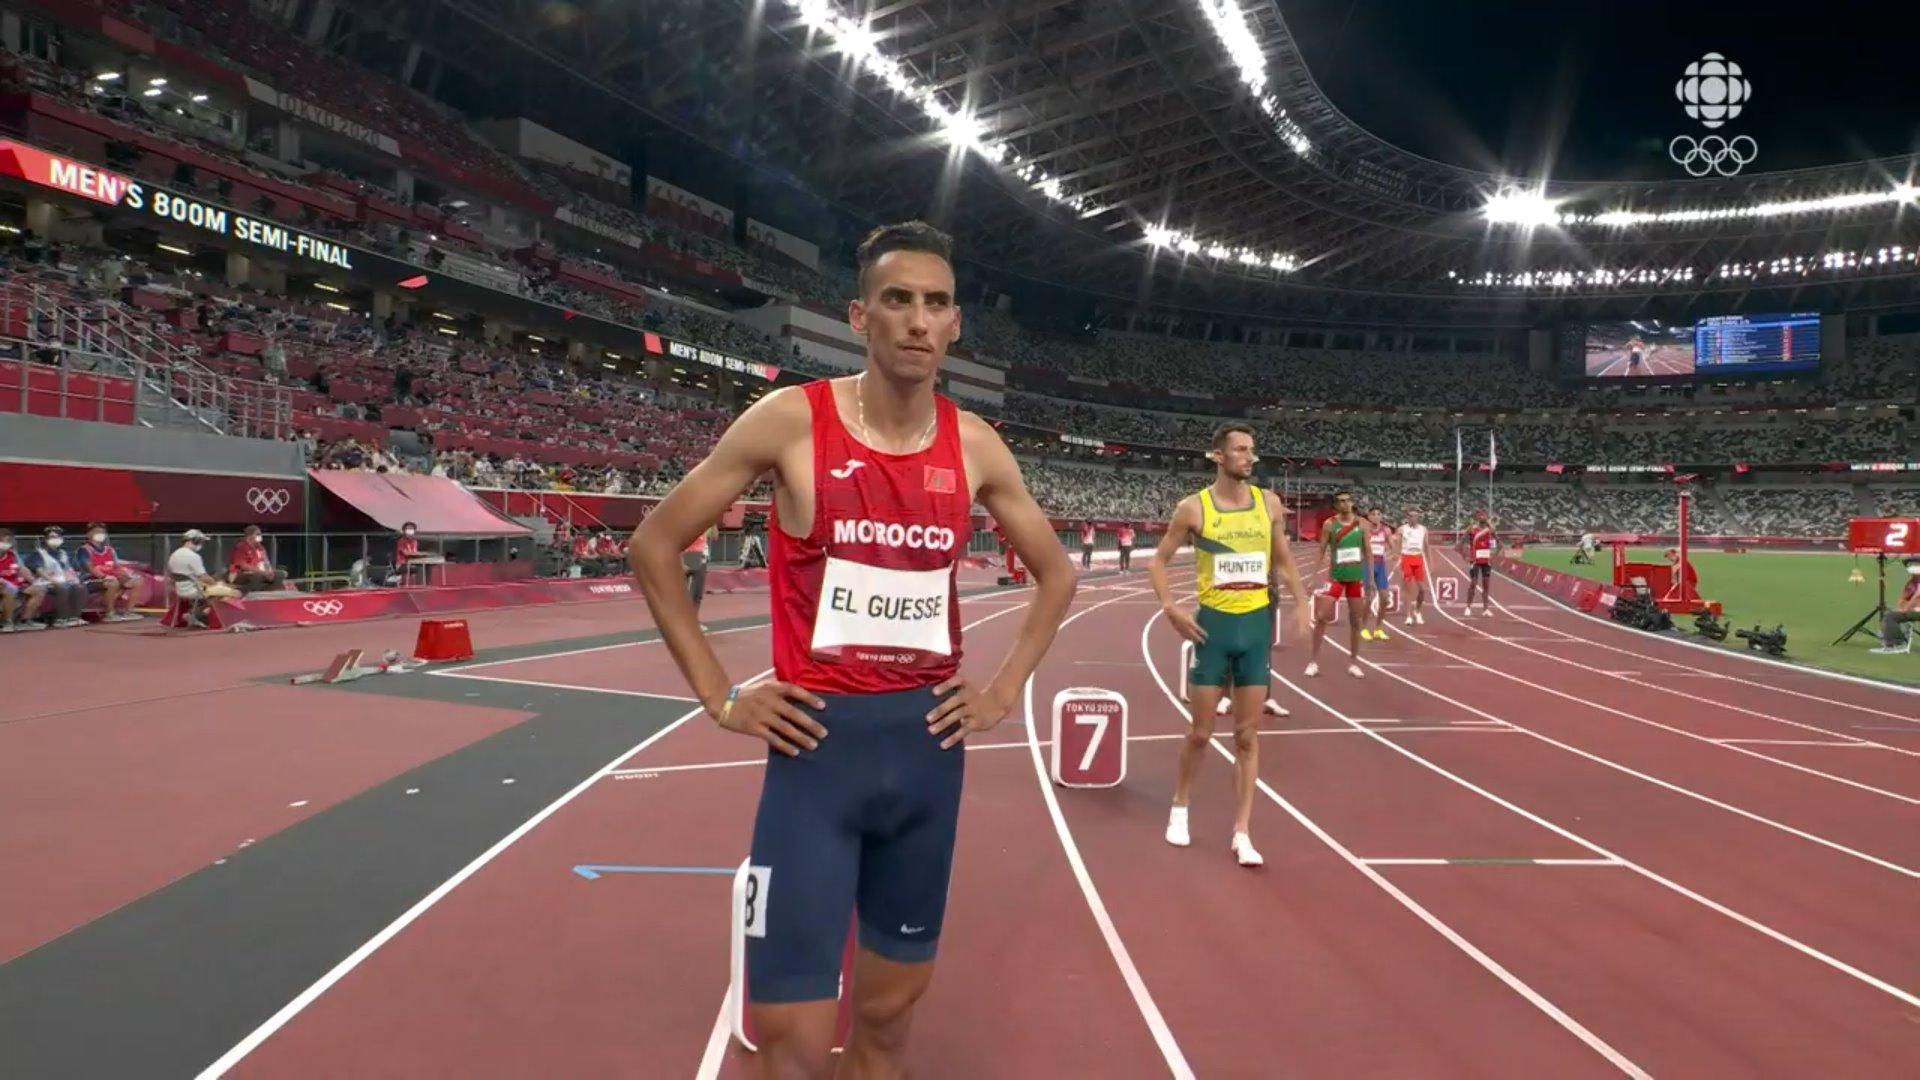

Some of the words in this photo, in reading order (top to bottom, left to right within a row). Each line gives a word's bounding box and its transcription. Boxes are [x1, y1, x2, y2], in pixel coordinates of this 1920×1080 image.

[50, 158, 144, 209] MEN'S
[153, 192, 227, 234] 800M
[234, 216, 353, 270] SEMI-FINAL
[833, 519, 955, 550] MOROCCO
[1885, 523, 1909, 547] 2
[1218, 560, 1263, 573] HUNTER
[831, 586, 857, 613] EL
[868, 594, 942, 620] GUESSE
[1443, 583, 1453, 598] 2
[1066, 703, 1096, 713] TOKYO
[1097, 703, 1120, 713] 2020
[1074, 714, 1109, 771] 7
